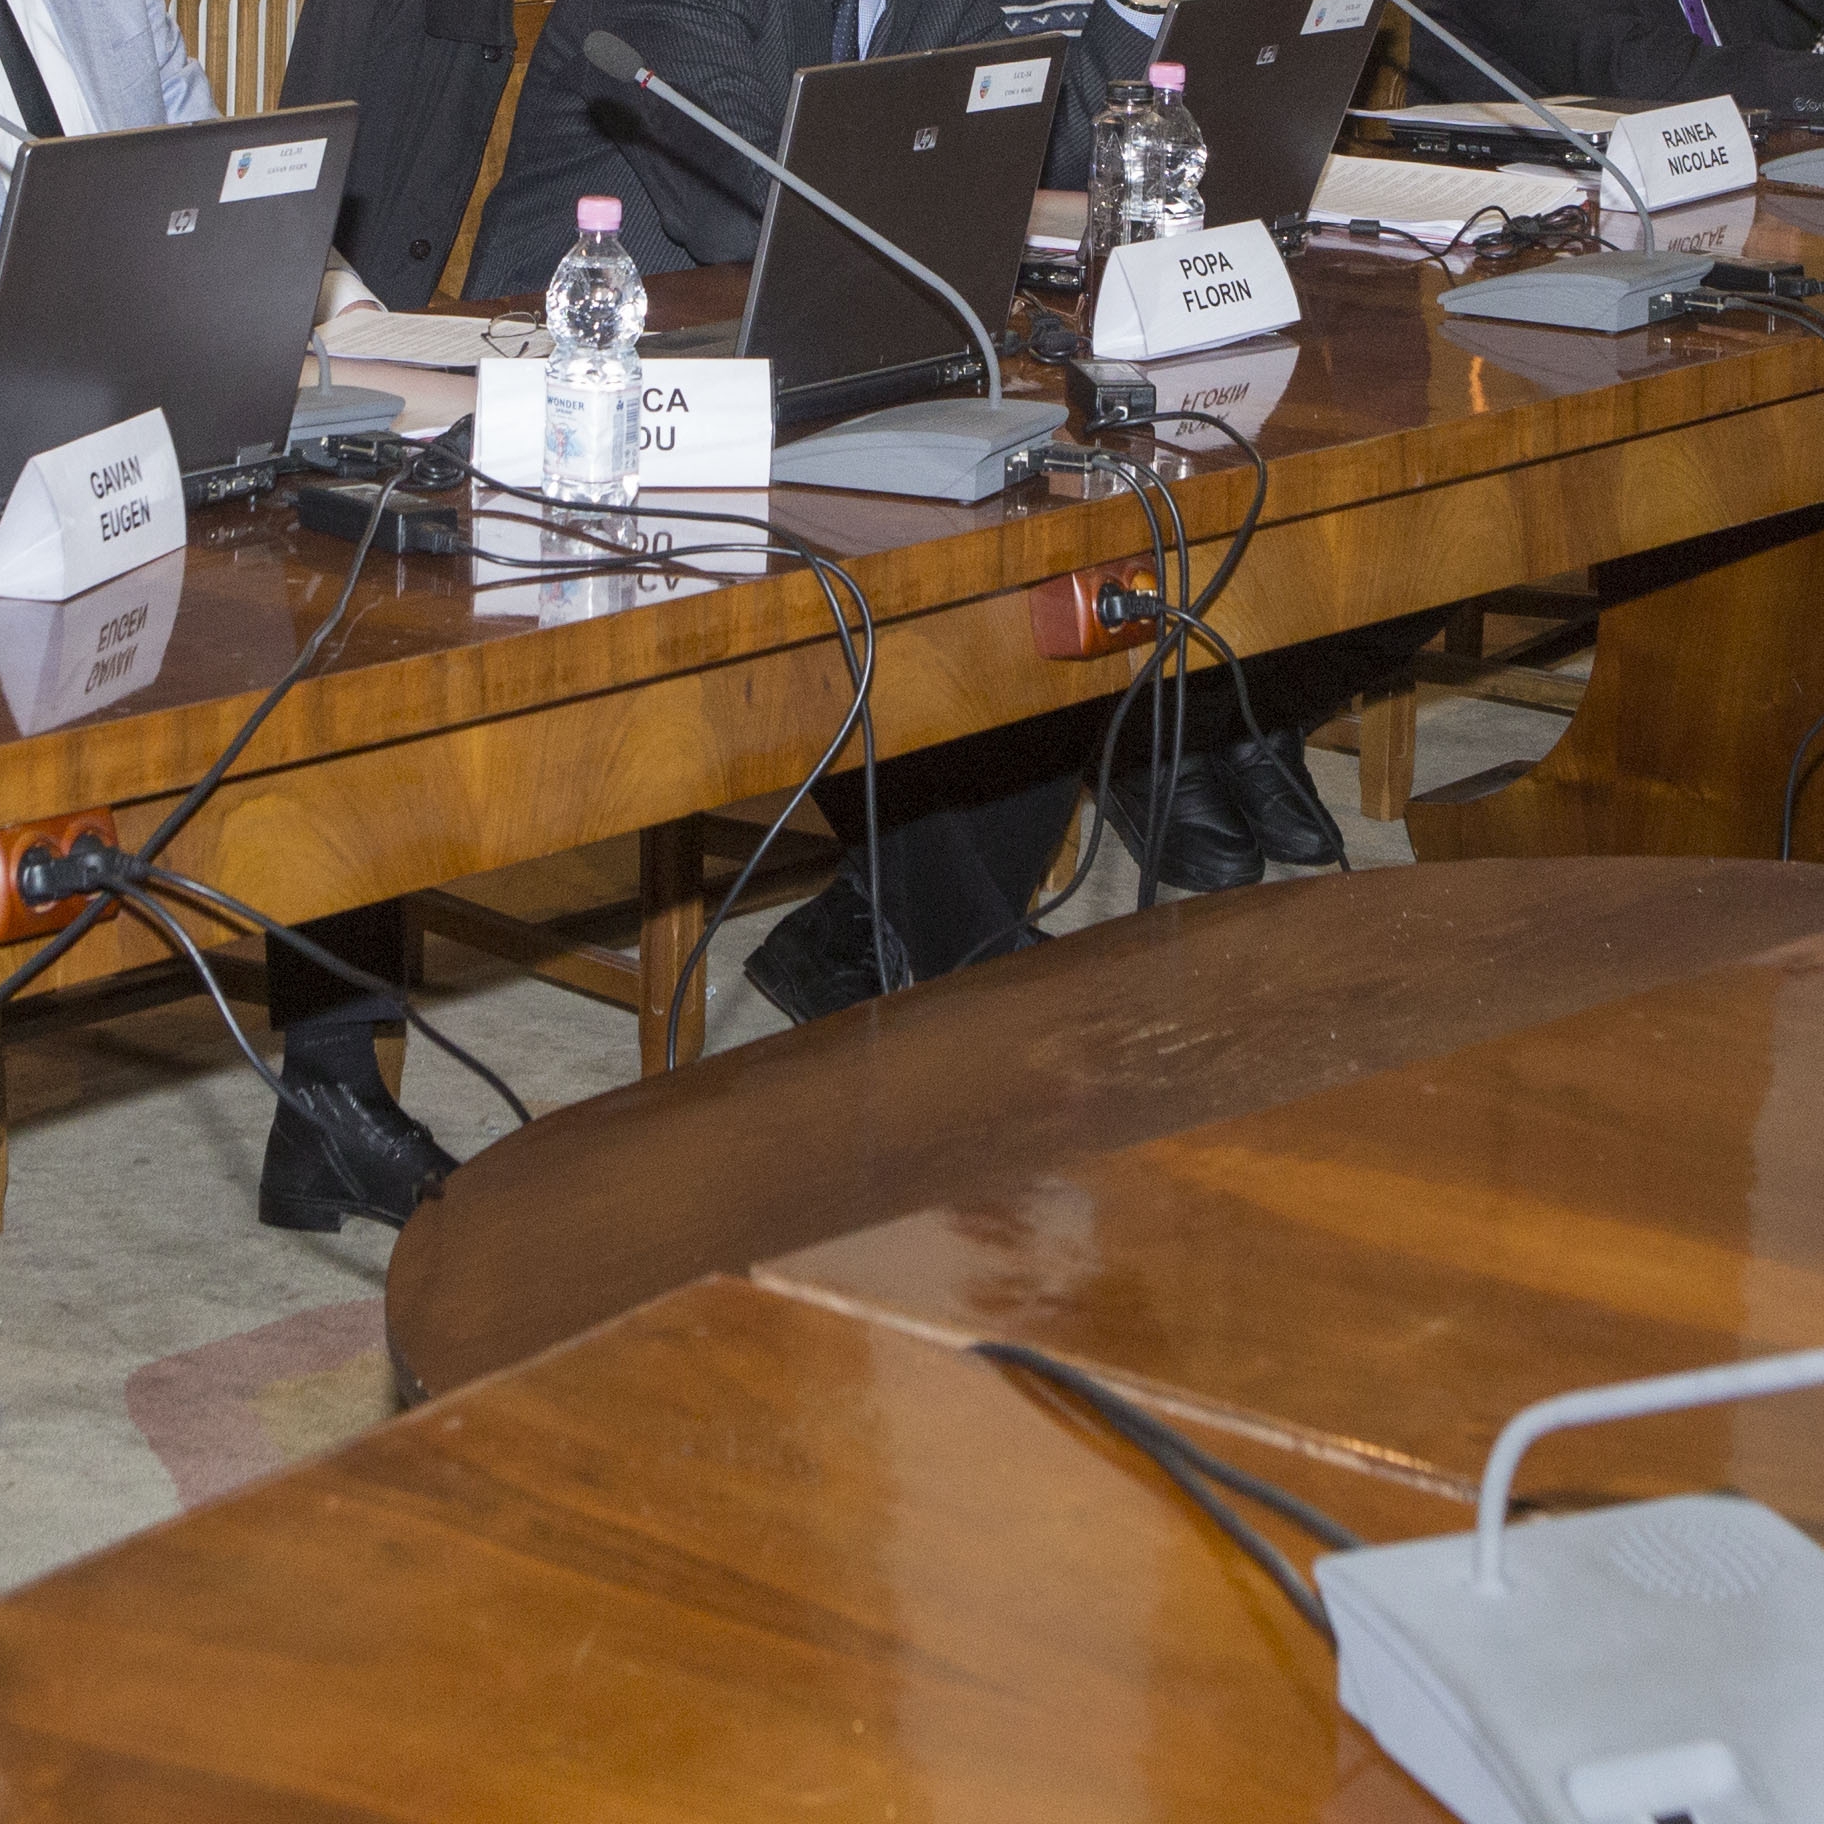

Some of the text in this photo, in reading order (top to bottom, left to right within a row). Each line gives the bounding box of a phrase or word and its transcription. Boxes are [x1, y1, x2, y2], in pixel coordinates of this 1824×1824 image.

[1662, 122, 1717, 149] RAINEA
[1667, 146, 1729, 176] NICOLAE
[1179, 251, 1234, 280] POPA
[1182, 278, 1252, 313] FLORIN
[547, 395, 585, 411] WONDER
[642, 387, 690, 413] CA
[90, 455, 144, 499] GAVAN
[100, 496, 151, 542] EUGEN
